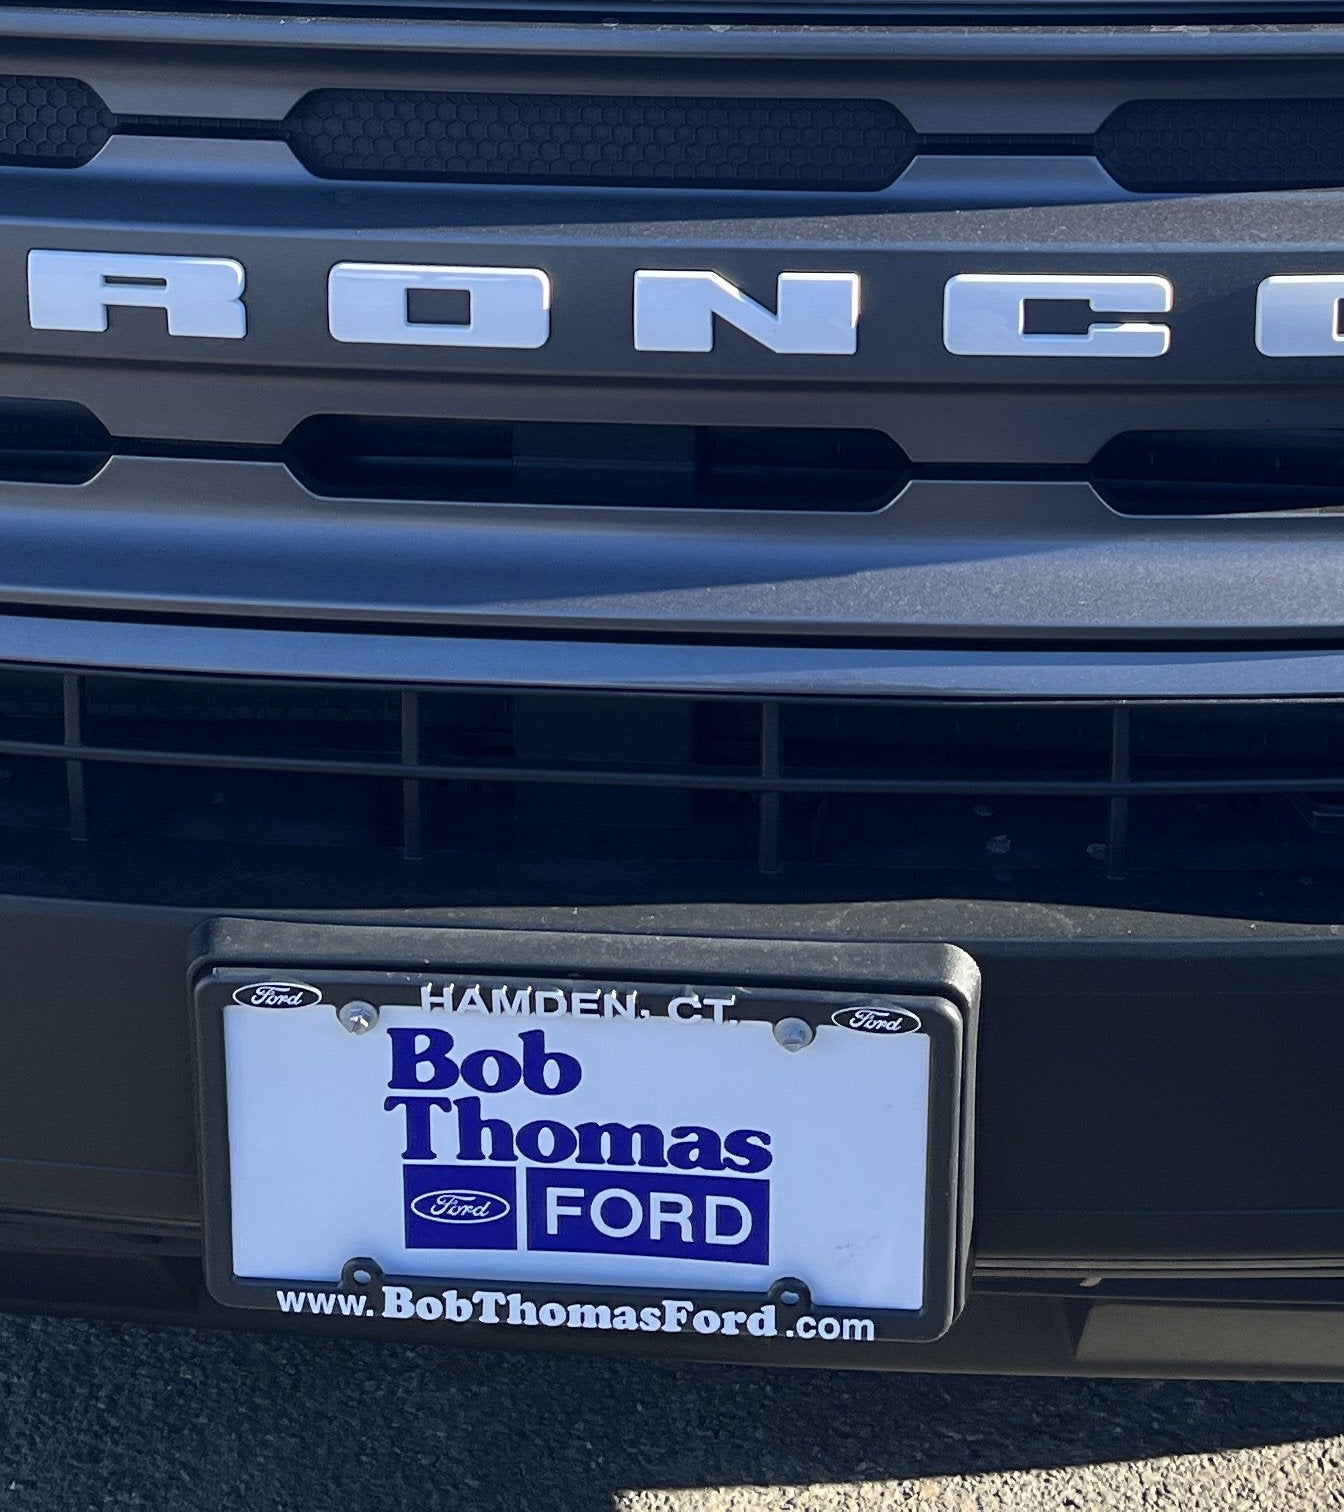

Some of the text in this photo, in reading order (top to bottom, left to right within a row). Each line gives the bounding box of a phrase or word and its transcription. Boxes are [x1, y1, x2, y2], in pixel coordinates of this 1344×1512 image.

[250, 985, 304, 1006] Ford
[420, 983, 744, 1026] HAMDEN, CT.
[849, 1009, 903, 1031] Ford
[387, 1027, 583, 1096] Bob
[383, 1096, 773, 1174] Thomas
[429, 1193, 492, 1218] Ford
[545, 1186, 753, 1246] FORD
[276, 1286, 876, 1342] www.BobThomasFord.com
